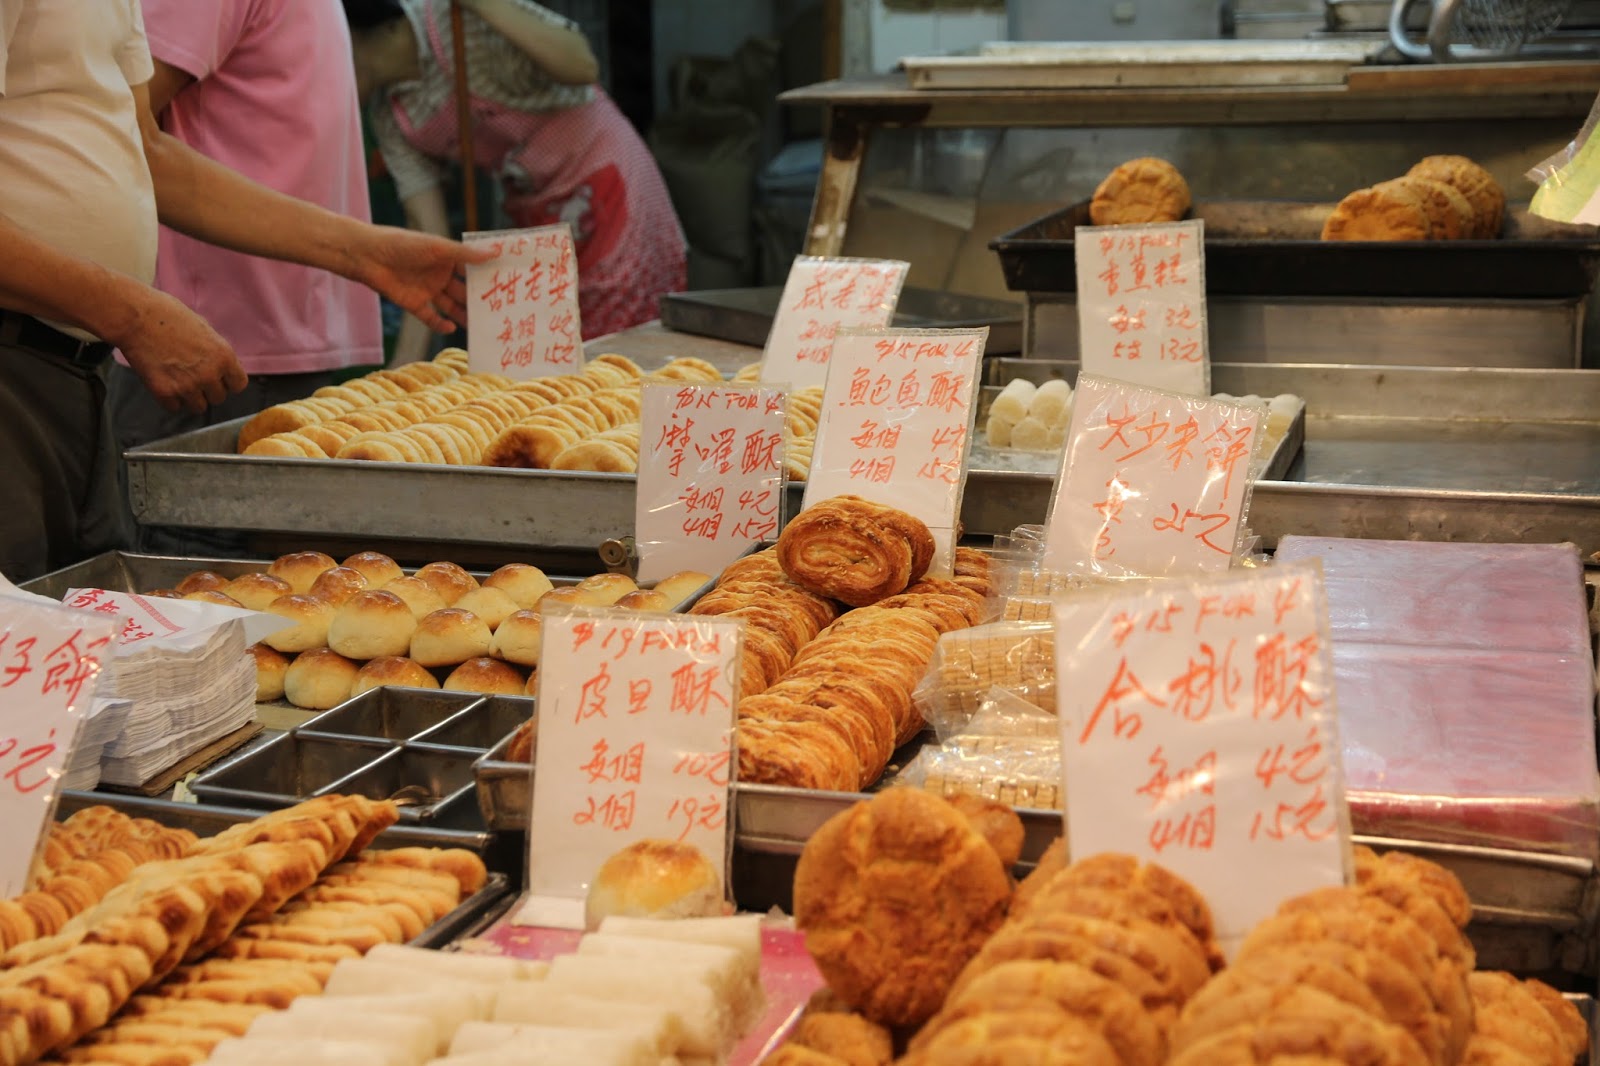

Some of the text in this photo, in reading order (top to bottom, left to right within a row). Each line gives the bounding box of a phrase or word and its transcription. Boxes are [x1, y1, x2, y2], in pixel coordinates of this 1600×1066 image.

[875, 339, 974, 364] $15 FOR 4
[725, 392, 759, 410] FOR
[765, 392, 782, 415] 4
[839, 367, 966, 412] 鮑魚酥
[851, 420, 902, 450] 每個
[850, 456, 896, 484] 4個
[678, 481, 777, 515] 每個 4元
[683, 513, 777, 541] 4個 15元
[1152, 503, 1232, 555] 25元
[1196, 595, 1255, 633] FOR
[1273, 579, 1301, 624] 4
[572, 622, 634, 659] $19
[641, 627, 697, 655] FOR
[1079, 631, 1324, 745] 合桃酥
[579, 738, 645, 784] 每個
[1136, 727, 1327, 800] 每個 4元
[573, 790, 726, 841] 2個 19元
[1150, 787, 1338, 852] 4個 15元
